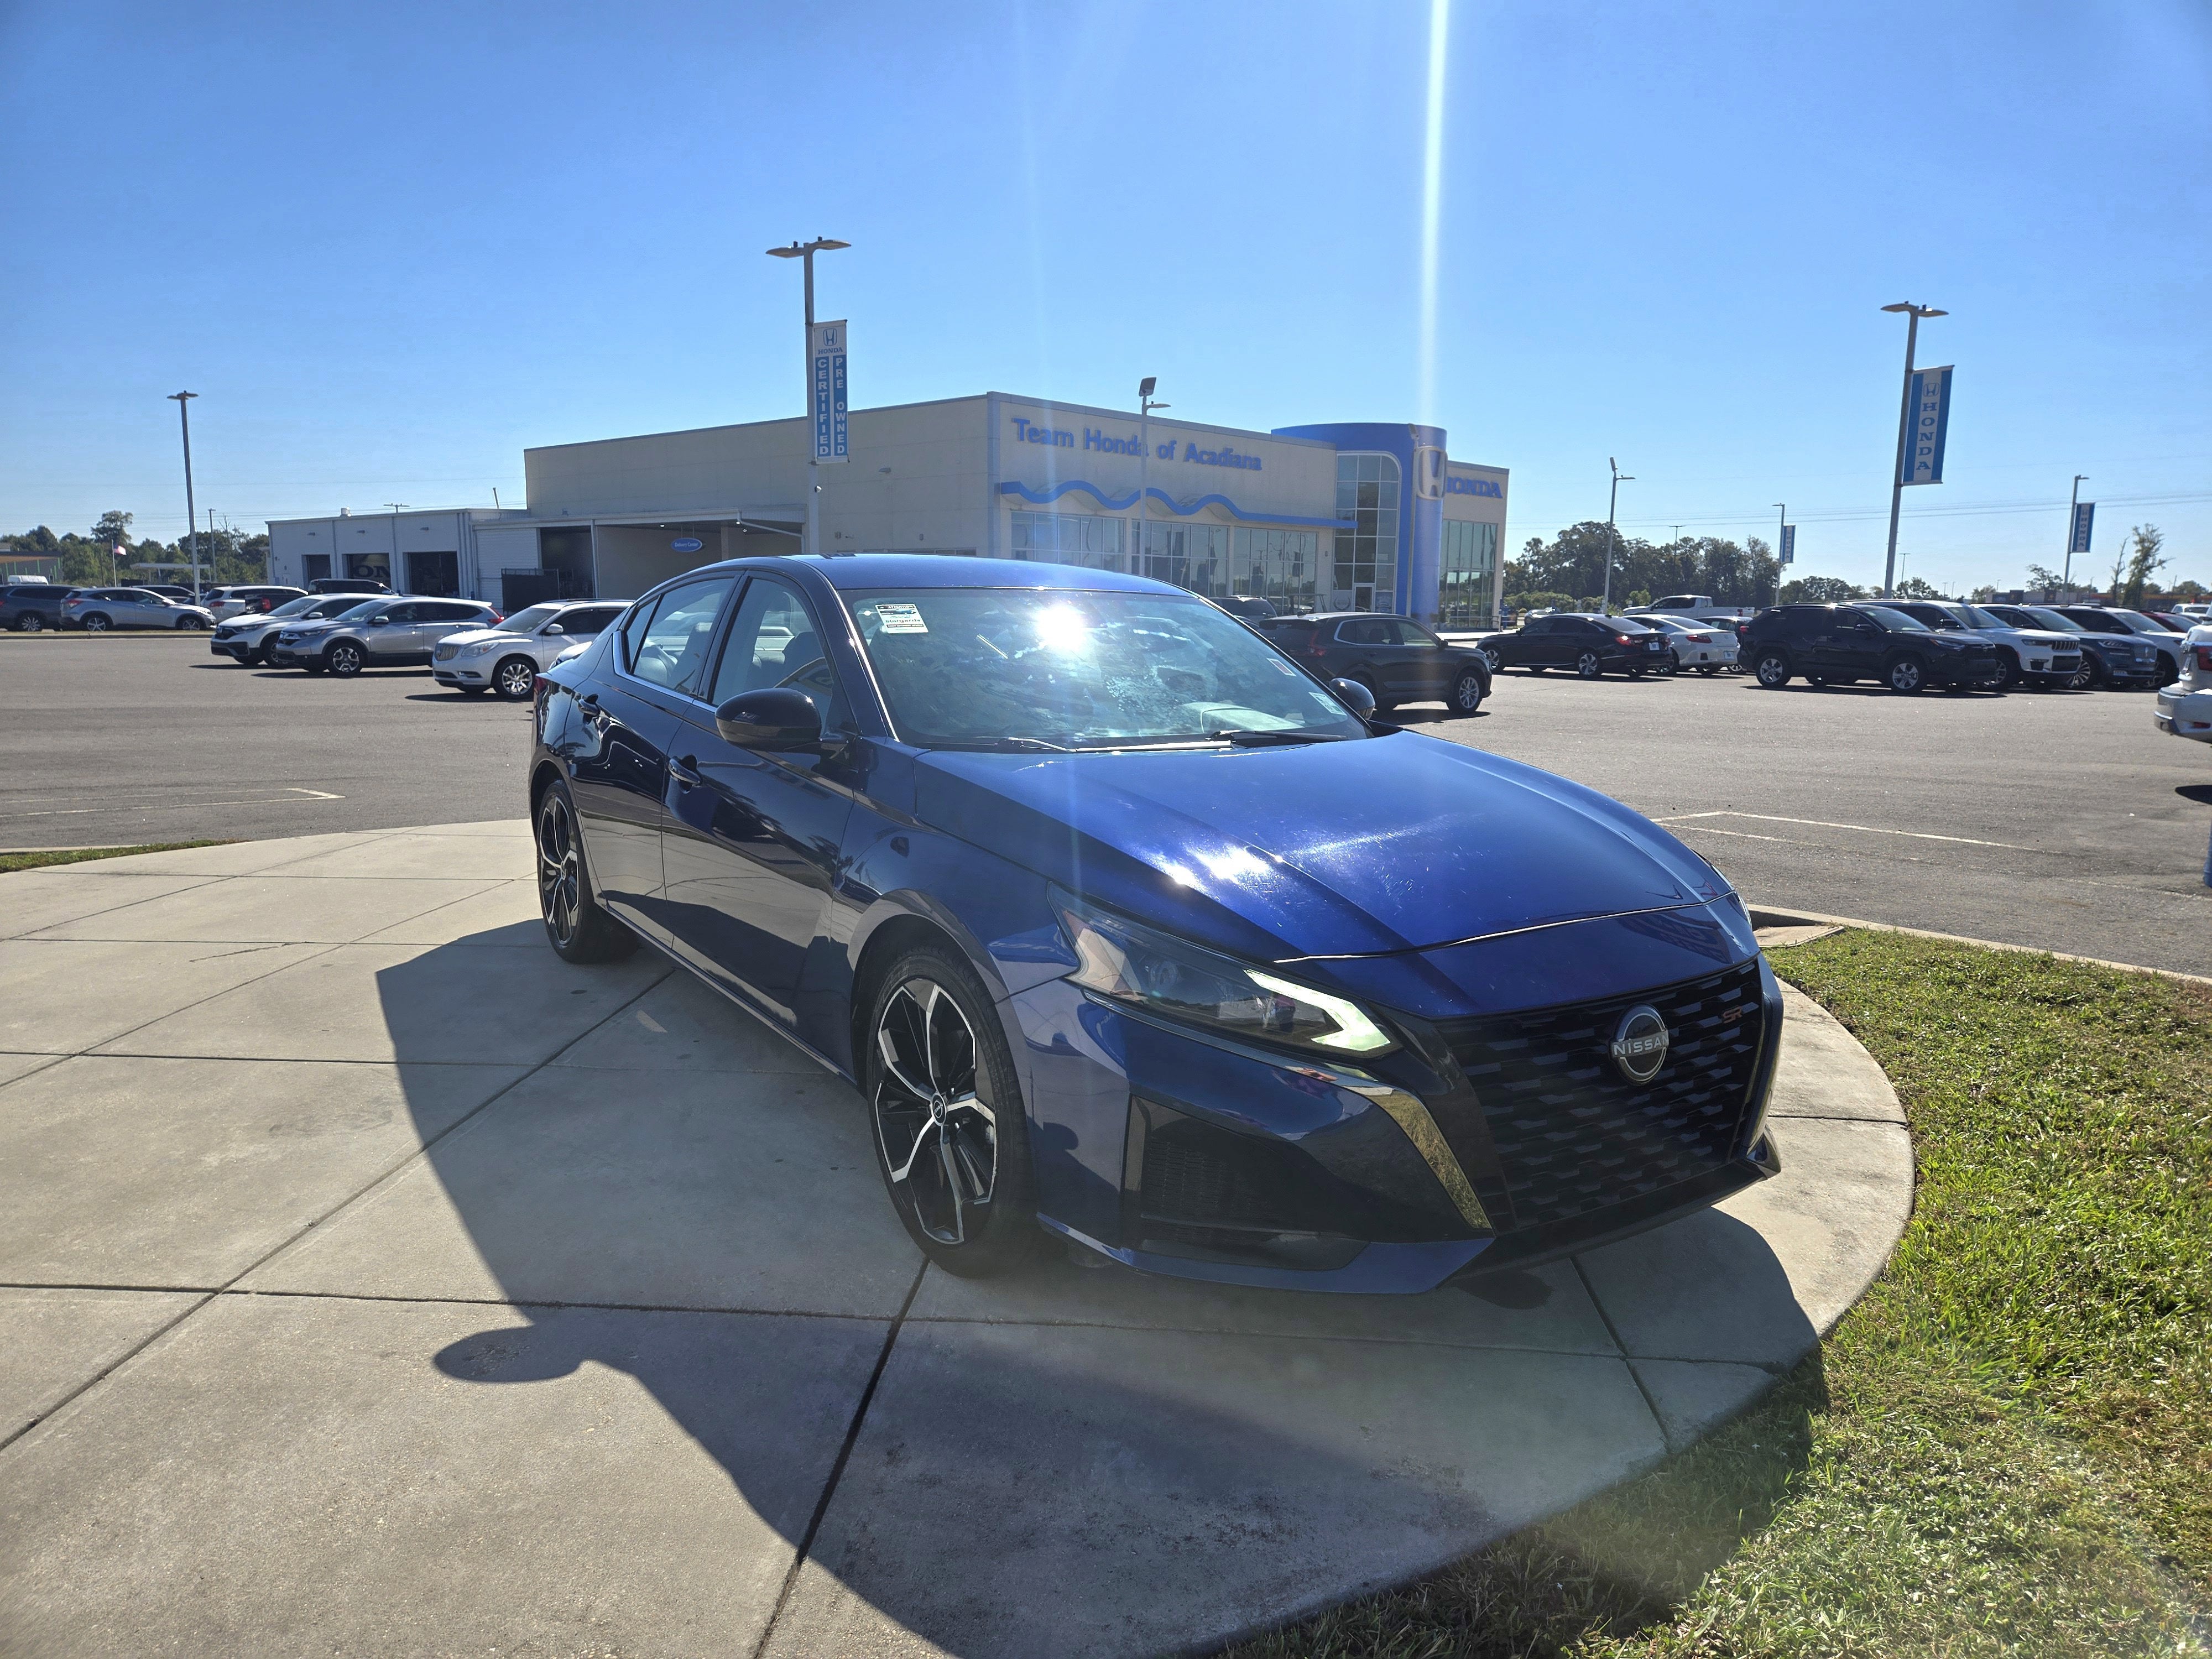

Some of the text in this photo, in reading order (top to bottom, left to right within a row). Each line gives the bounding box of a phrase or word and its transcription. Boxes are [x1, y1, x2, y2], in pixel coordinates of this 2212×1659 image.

[817, 358, 829, 455] CERTIFIED
[836, 357, 847, 453] PRE OWNED
[1011, 418, 1074, 448] Team
[1156, 440, 1177, 460] of
[1183, 442, 1262, 471] Acadiana
[1916, 402, 1938, 470] HONDA
[2078, 517, 2087, 546] HONDA
[1723, 1005, 1743, 1024] SR
[1613, 1034, 1669, 1055] NISSAN
